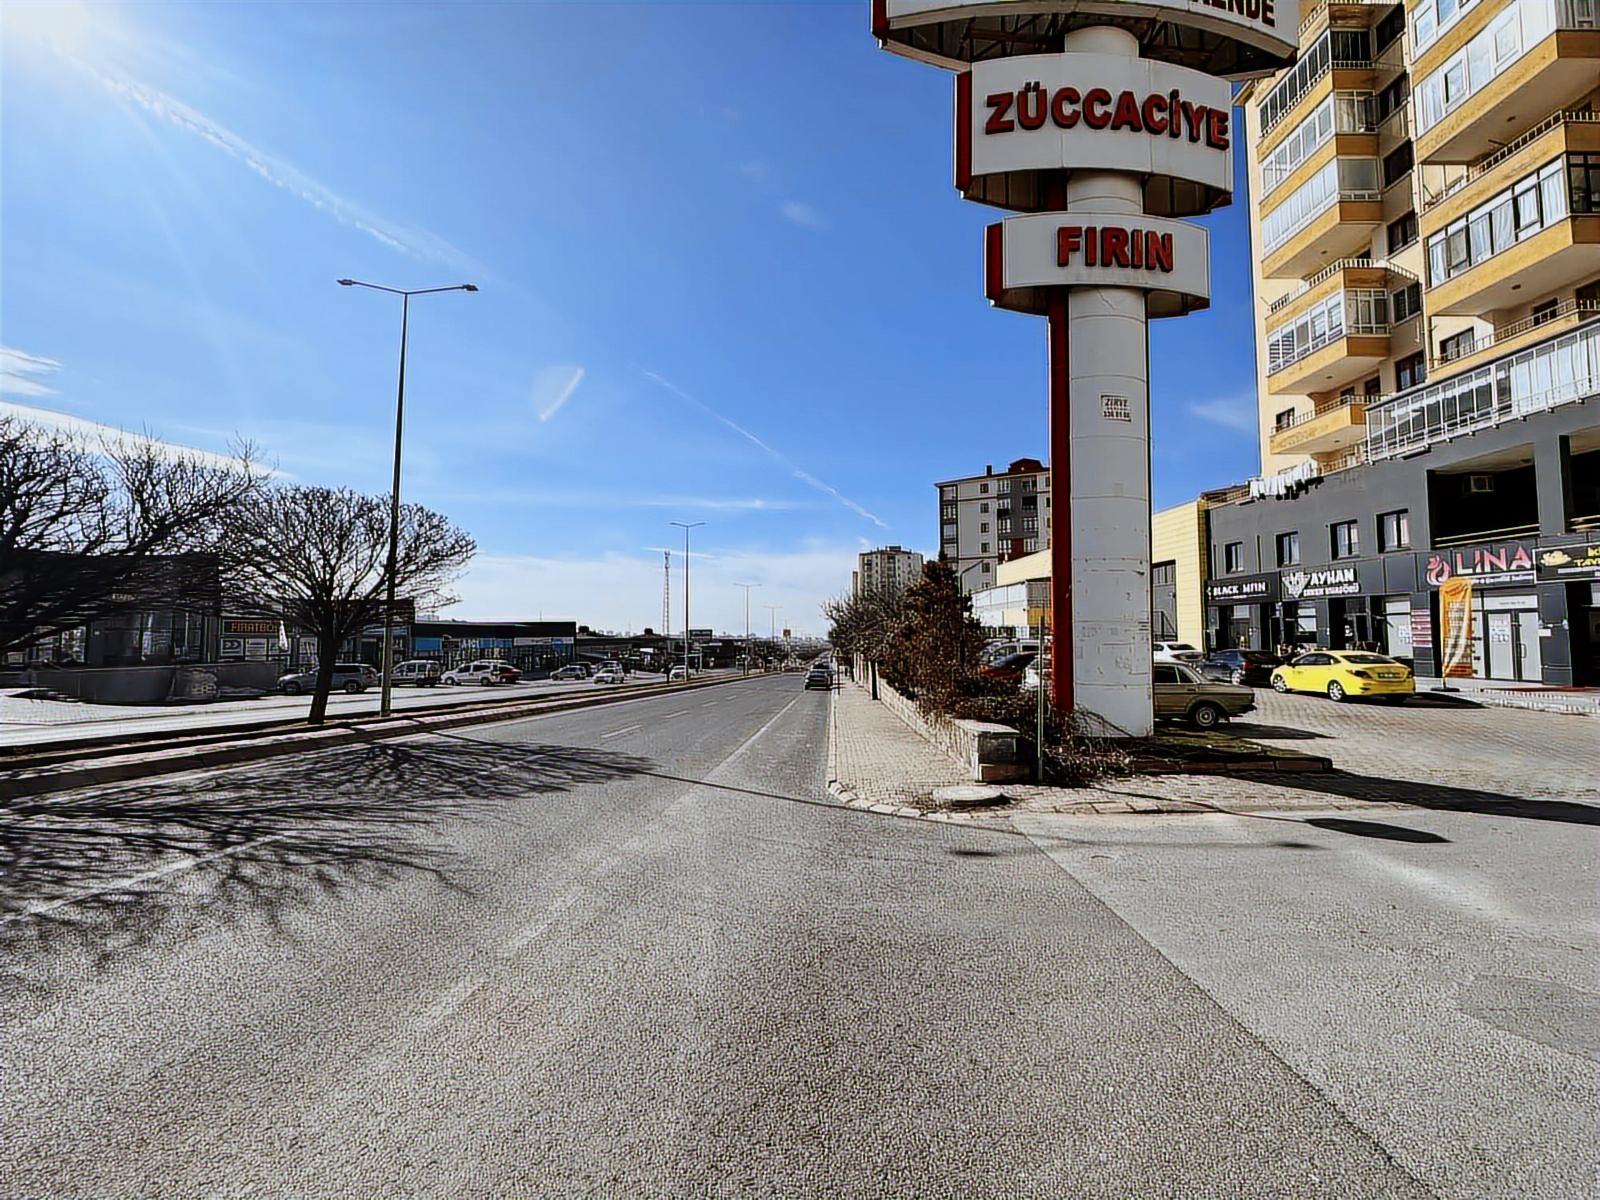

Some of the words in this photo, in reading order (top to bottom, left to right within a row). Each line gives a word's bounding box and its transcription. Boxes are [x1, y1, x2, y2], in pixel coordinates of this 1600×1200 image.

[985, 81, 1230, 151] ZÜCCACİYE
[1057, 226, 1174, 273] FIRIN
[1213, 585, 1239, 596] BLACK
[1310, 568, 1354, 586] AYHAN
